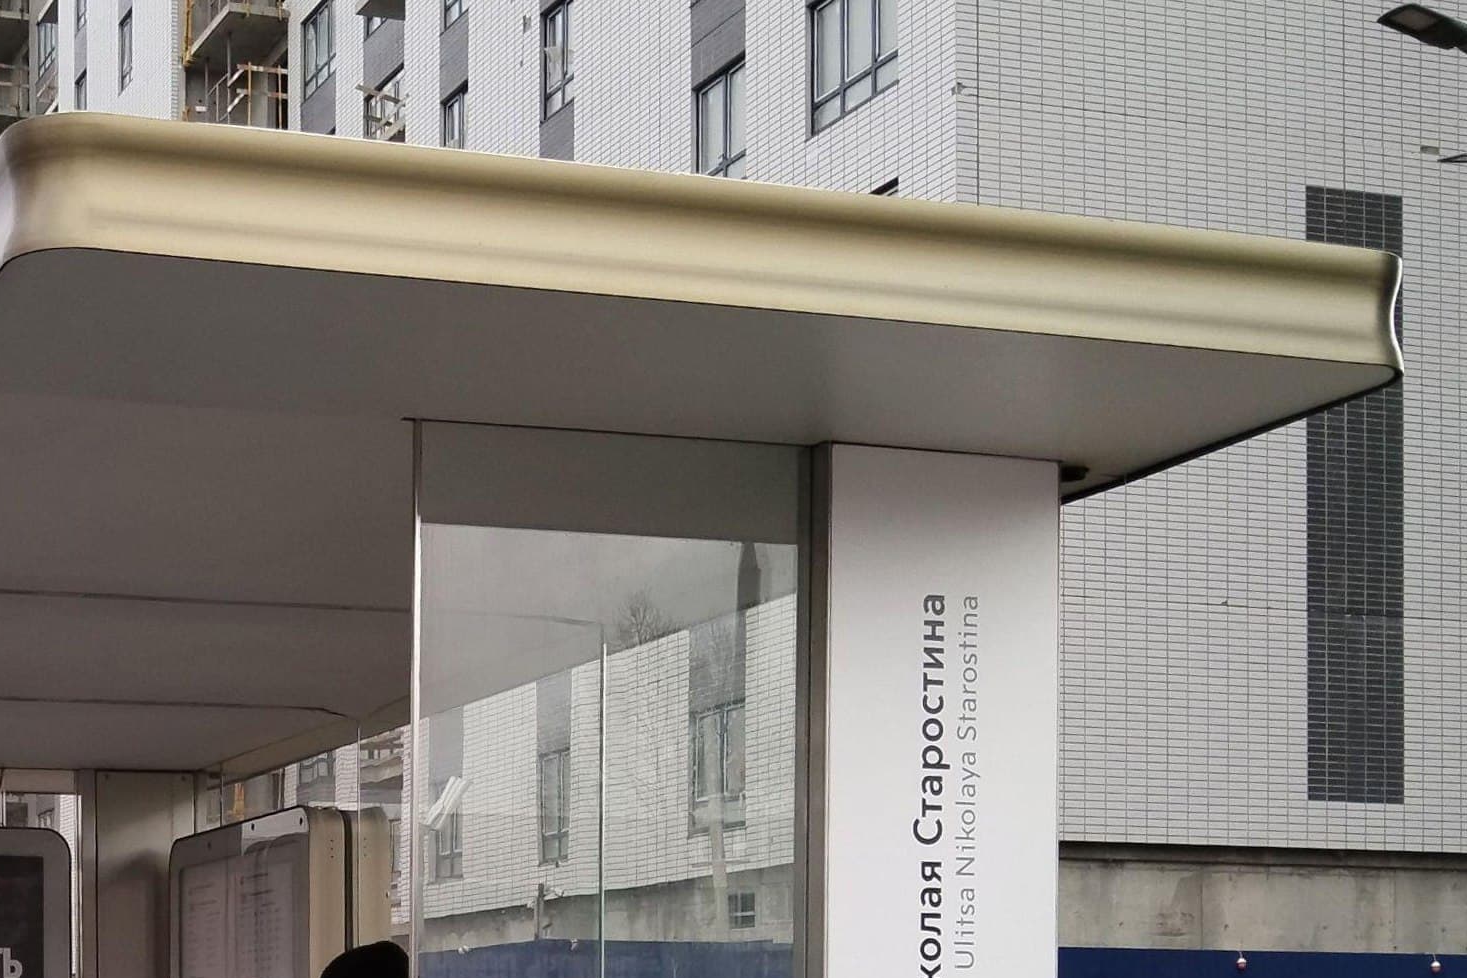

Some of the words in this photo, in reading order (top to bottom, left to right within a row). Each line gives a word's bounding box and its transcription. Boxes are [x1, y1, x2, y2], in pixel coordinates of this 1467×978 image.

[913, 594, 950, 845] Старостина
[957, 596, 978, 741] Starostina
[955, 751, 981, 876] Nikolaya
[954, 887, 975, 969] Ulitsa
